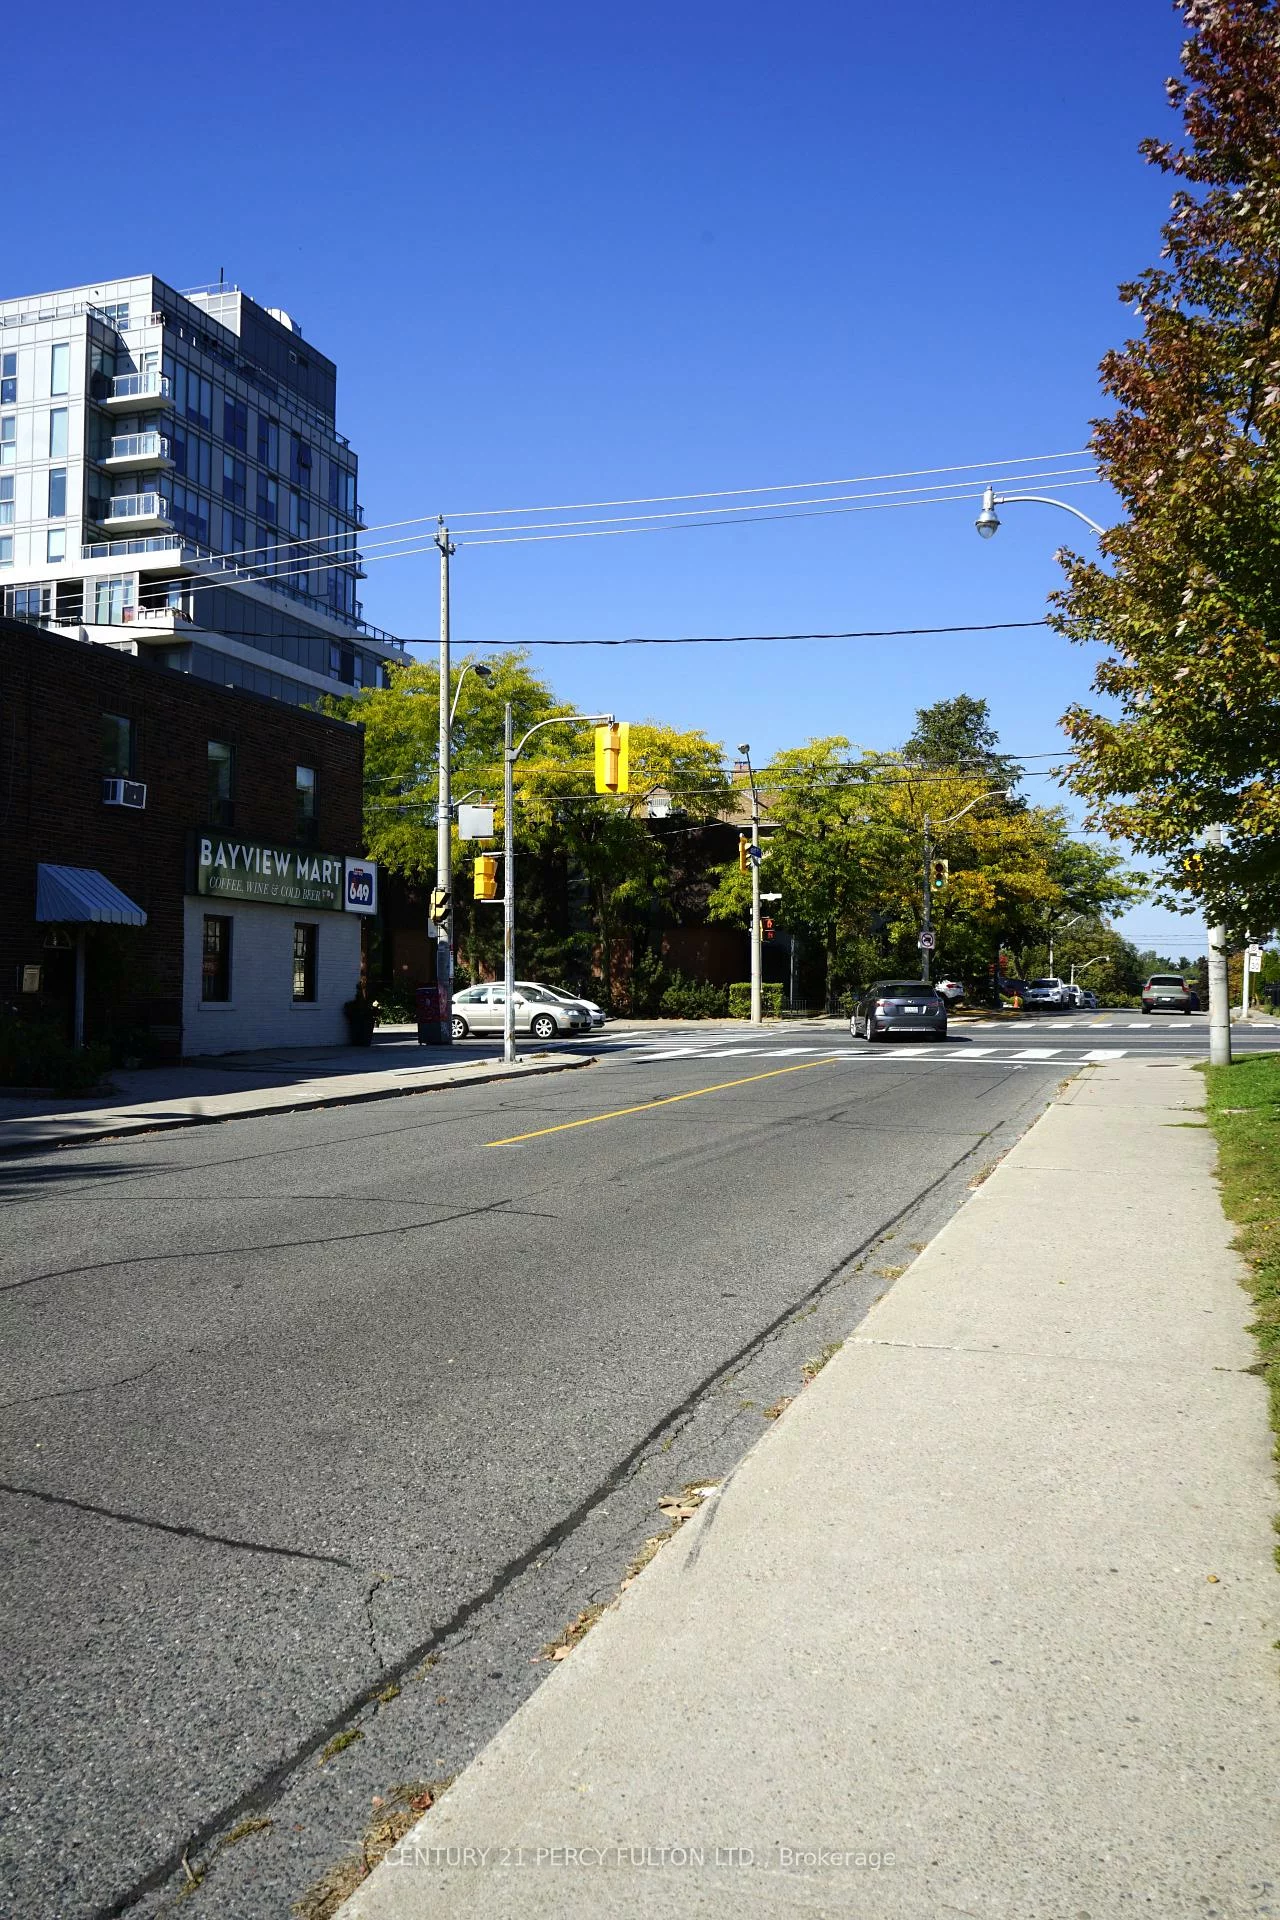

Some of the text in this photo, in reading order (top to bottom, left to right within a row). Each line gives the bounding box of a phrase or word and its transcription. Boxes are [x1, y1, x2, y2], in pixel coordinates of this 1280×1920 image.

[201, 838, 342, 885] BAYVIEW MART
[246, 880, 270, 895] WINE
[271, 884, 279, 896] &
[280, 885, 301, 899] COLD
[302, 888, 321, 902] BEER
[350, 882, 370, 902] 649
